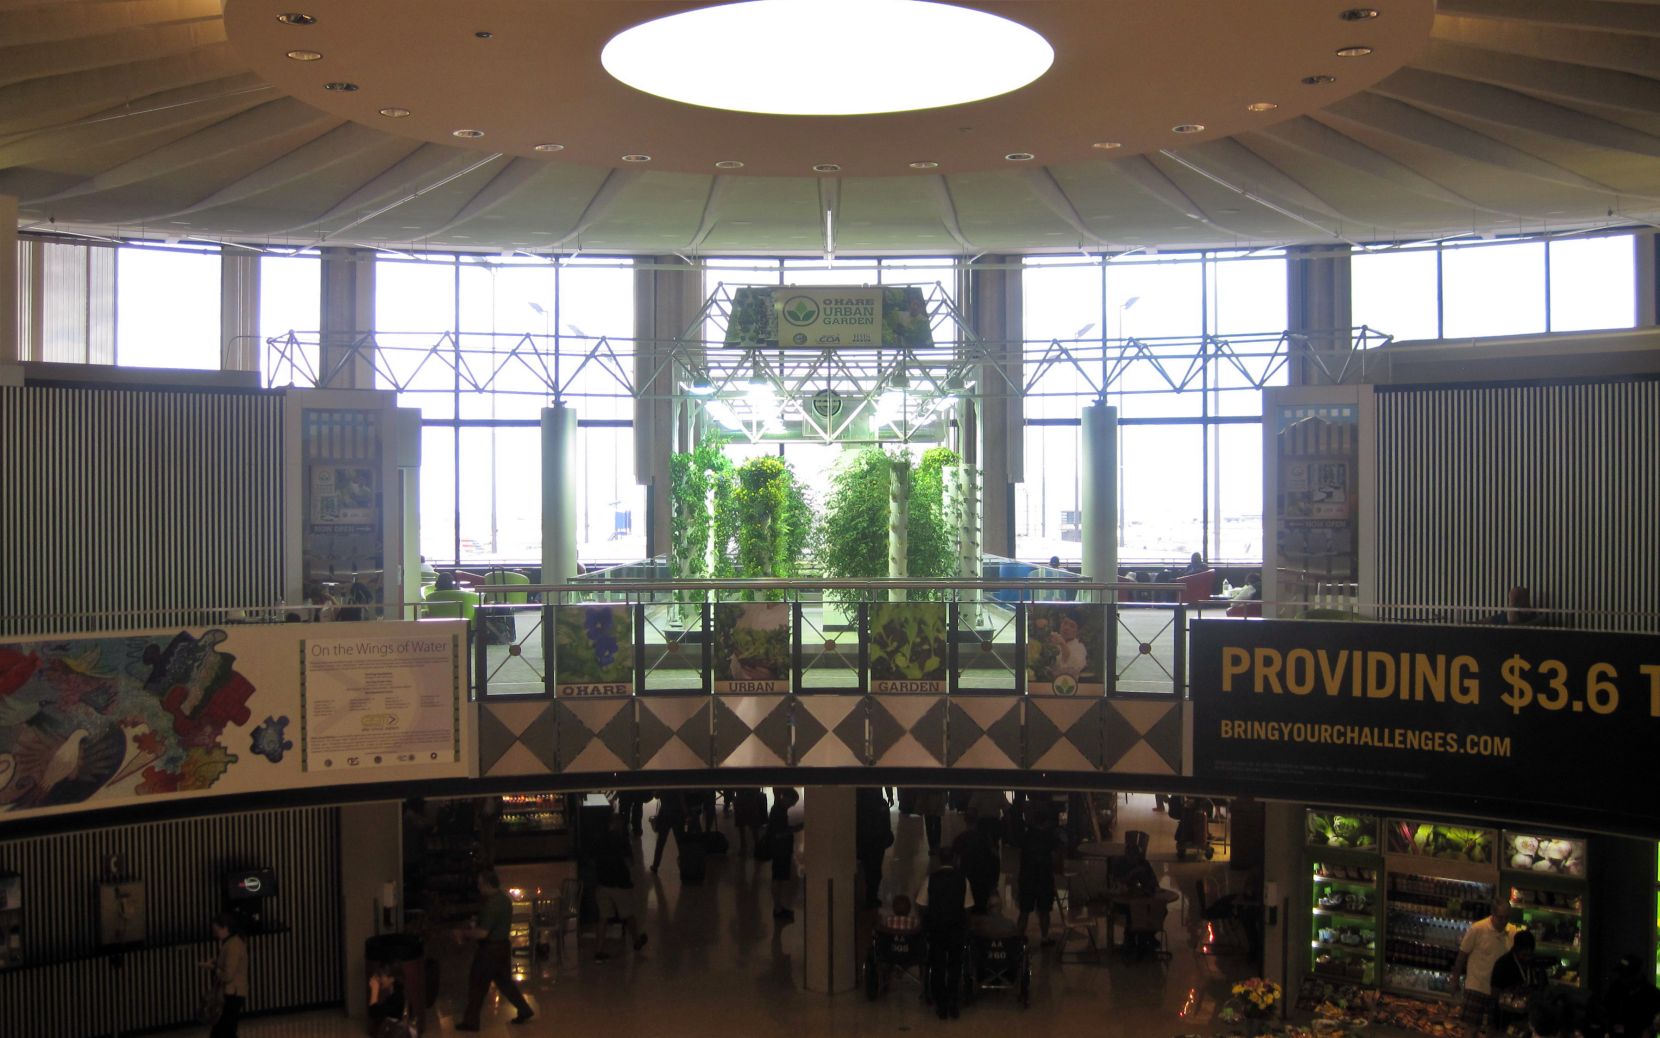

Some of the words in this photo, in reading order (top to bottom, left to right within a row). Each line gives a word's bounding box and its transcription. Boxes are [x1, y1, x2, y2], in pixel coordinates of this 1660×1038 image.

[823, 307, 873, 316] URBAN
[823, 317, 873, 325] GARDEN
[311, 645, 330, 657] On
[333, 643, 353, 656] the
[355, 642, 394, 657] Wings
[396, 642, 410, 654] of
[412, 641, 447, 654] Water
[1221, 646, 1480, 705] PROVIDING
[1500, 654, 1620, 715] $3.6
[728, 681, 775, 692] URBAN
[878, 681, 940, 692] GARDEN
[1220, 719, 1512, 757] BRINGYOURCHALLENGES.COM
